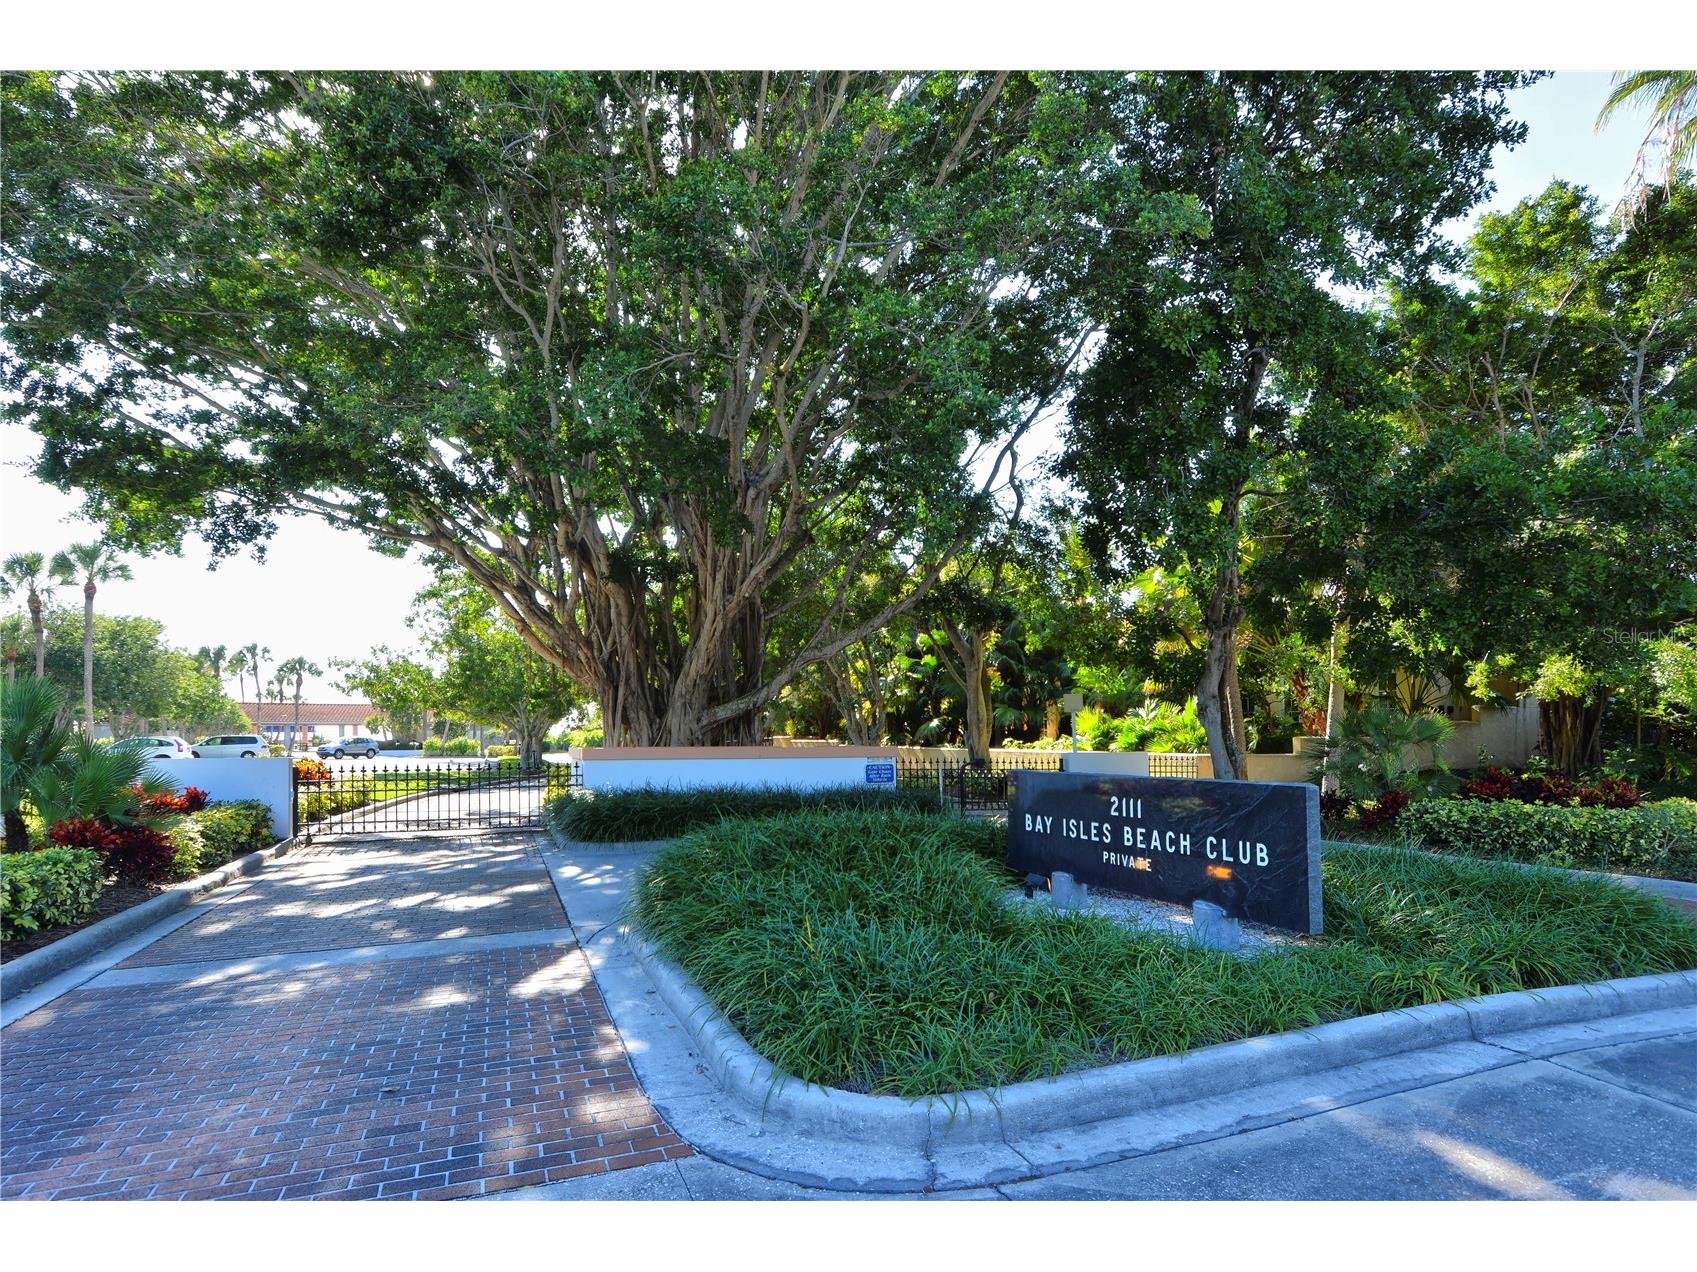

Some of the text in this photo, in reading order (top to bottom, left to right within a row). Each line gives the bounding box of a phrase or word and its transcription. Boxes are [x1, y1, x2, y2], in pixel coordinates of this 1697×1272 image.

[1110, 796, 1142, 818] 2111
[1025, 813, 1269, 867] BAY ISLES BEACH CLUB
[1103, 851, 1152, 872] PRIVATE
